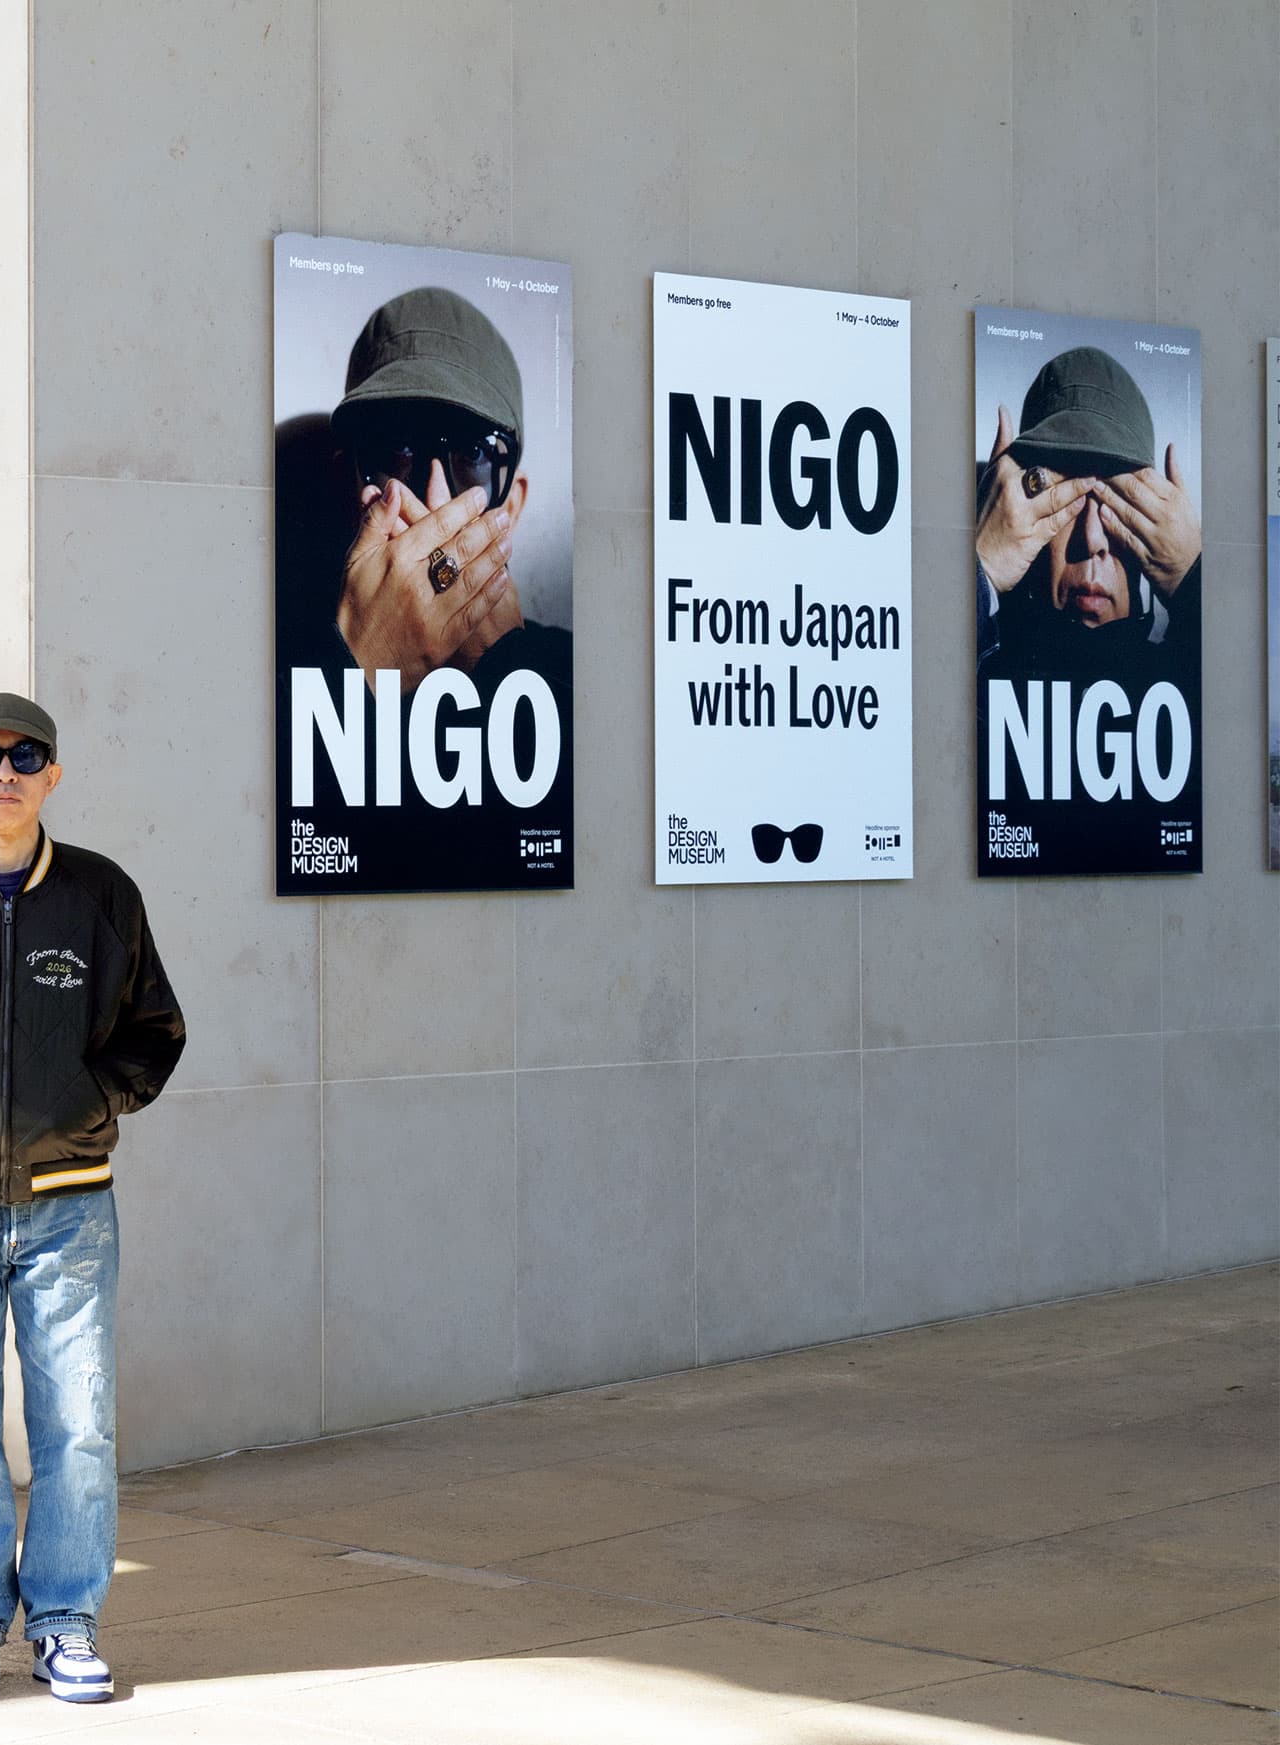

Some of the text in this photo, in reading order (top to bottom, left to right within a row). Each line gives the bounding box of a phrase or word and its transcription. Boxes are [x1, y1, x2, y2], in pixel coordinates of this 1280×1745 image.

[290, 256, 365, 275] Members go free
[486, 276, 490, 287] 1
[492, 277, 511, 292] May
[519, 280, 524, 291] 4
[526, 280, 560, 294] October
[667, 292, 732, 310] Members go free
[836, 312, 840, 321] 1
[842, 312, 857, 326] May
[865, 314, 869, 324] 4
[870, 314, 900, 328] October
[987, 324, 1044, 341] Members go free
[1134, 341, 1138, 350] 1
[1140, 341, 1153, 354] May
[1165, 343, 1191, 355] October
[669, 392, 899, 535] NIGO
[668, 578, 900, 661] From Japan
[688, 663, 879, 730] with Love
[291, 667, 561, 808] NIGO
[988, 679, 1192, 803] NIGO
[668, 813, 688, 829] the
[988, 810, 1006, 825] the
[291, 819, 315, 836] the
[989, 826, 1032, 842] DESIGN
[291, 837, 349, 855] DESIGN
[669, 830, 717, 847] DESIGN
[669, 848, 725, 864] MUSEUM
[989, 843, 1039, 858] MUSEUM
[291, 856, 358, 874] MUSEUM
[26, 949, 58, 966] From
[46, 962, 72, 973] 2026
[33, 974, 83, 988] with Love
